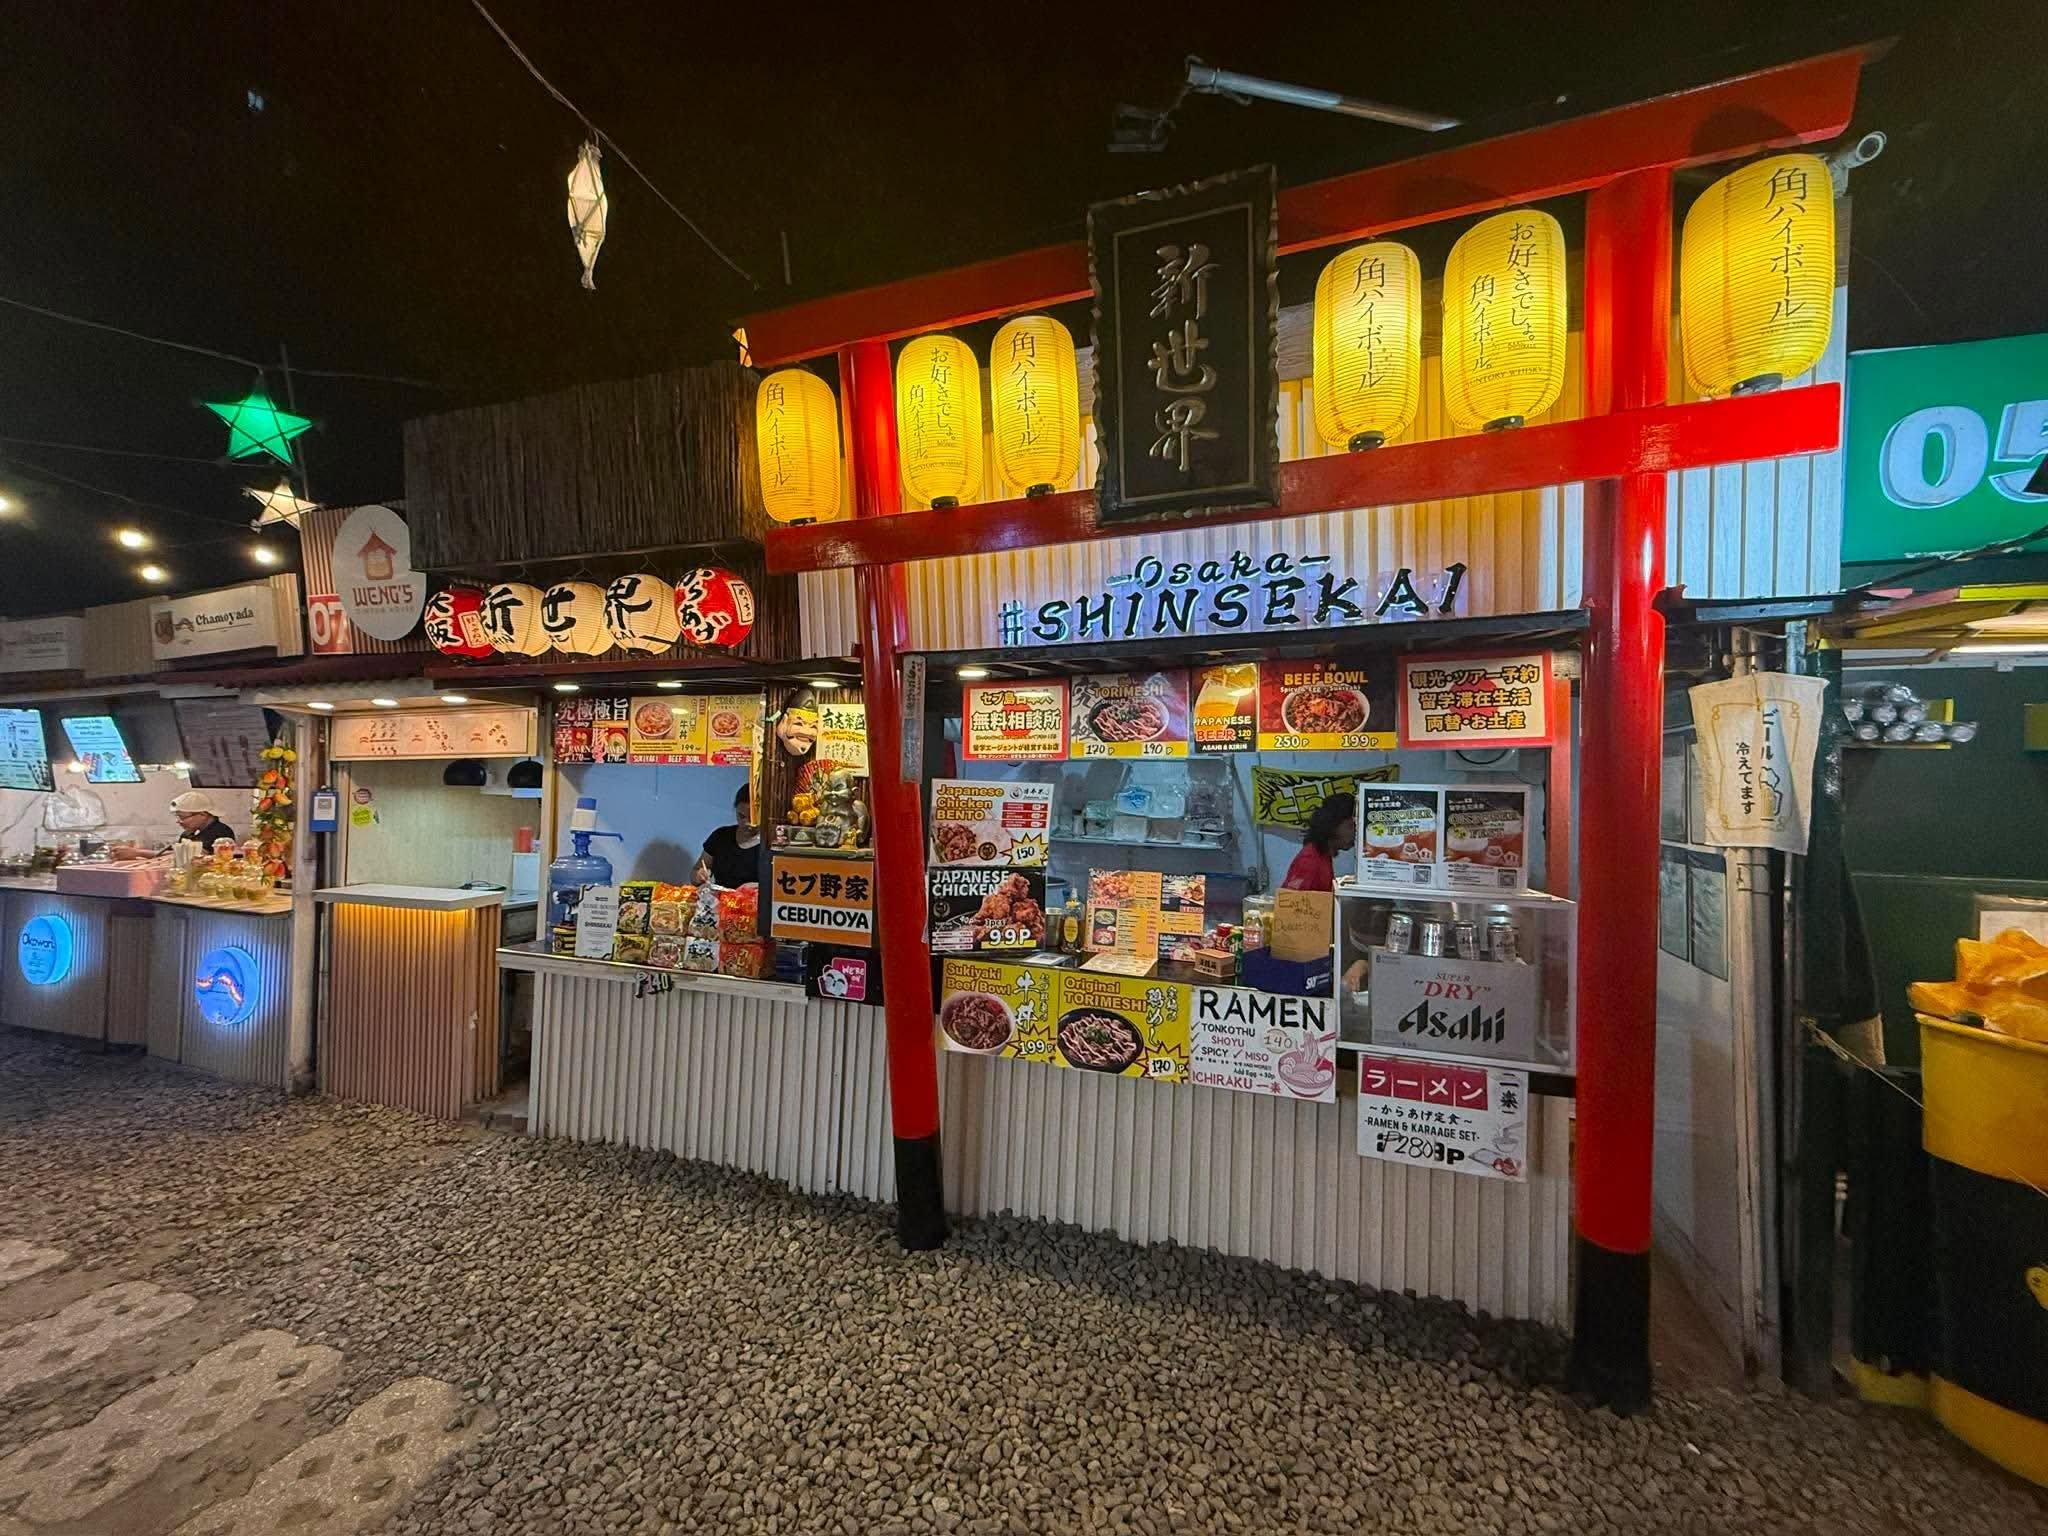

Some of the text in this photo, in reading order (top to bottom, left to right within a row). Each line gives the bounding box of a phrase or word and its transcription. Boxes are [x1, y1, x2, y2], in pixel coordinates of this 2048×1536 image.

[1764, 166, 1807, 323] 角ハイボール
[1352, 257, 1385, 394] 角ハイボール
[1149, 243, 1222, 473] 新世界
[1010, 331, 1041, 450] 角ハイボール
[765, 382, 792, 489] 角ハイボール
[352, 583, 414, 607] WENG'S
[998, 562, 1468, 646] #SHINSEKAI
[310, 601, 349, 646] 07
[1284, 670, 1369, 686] BEEF BOWL
[1409, 663, 1540, 689] 観光・ツアー予約
[1093, 683, 1164, 698] TORIMESHI
[1419, 687, 1532, 711] 留学滞在生活
[971, 708, 1062, 732] 無料相談所
[1195, 715, 1252, 727] JAPANESE
[1425, 710, 1526, 732] 両替・お土産
[1196, 728, 1236, 742] BEER
[1275, 735, 1301, 748] 250
[1342, 735, 1370, 748] 199
[1144, 743, 1163, 755] 190
[1735, 741, 1756, 815] 冷えてます
[936, 784, 1005, 798] Japanese
[936, 796, 993, 809] Chicken
[935, 808, 986, 822] BENTO
[1016, 846, 1035, 860] 150
[777, 870, 869, 902] セブ野家
[932, 869, 1009, 884] JAPANESE
[932, 883, 998, 897] CHICKEN
[777, 905, 869, 930] CEBUNOYA
[946, 962, 1002, 982] Sukiyaki
[945, 976, 1012, 996] Beef Bowl
[1064, 976, 1121, 995] Original
[1063, 990, 1149, 1013] TORIMESHI
[1199, 988, 1325, 1032] RAMEN
[1201, 1022, 1256, 1038] TONKOTHU
[1398, 999, 1505, 1044] Asahi
[1020, 1040, 1046, 1056] 199
[1211, 1035, 1245, 1048] SHOYU
[1263, 1035, 1293, 1049] 140
[1201, 1046, 1270, 1063] SPICY MISO
[1192, 1071, 1253, 1090] ICHIRAKU
[1366, 1068, 1484, 1101] ラーメン
[1402, 1122, 1408, 1132] &
[1411, 1123, 1456, 1139] KARAAGE
